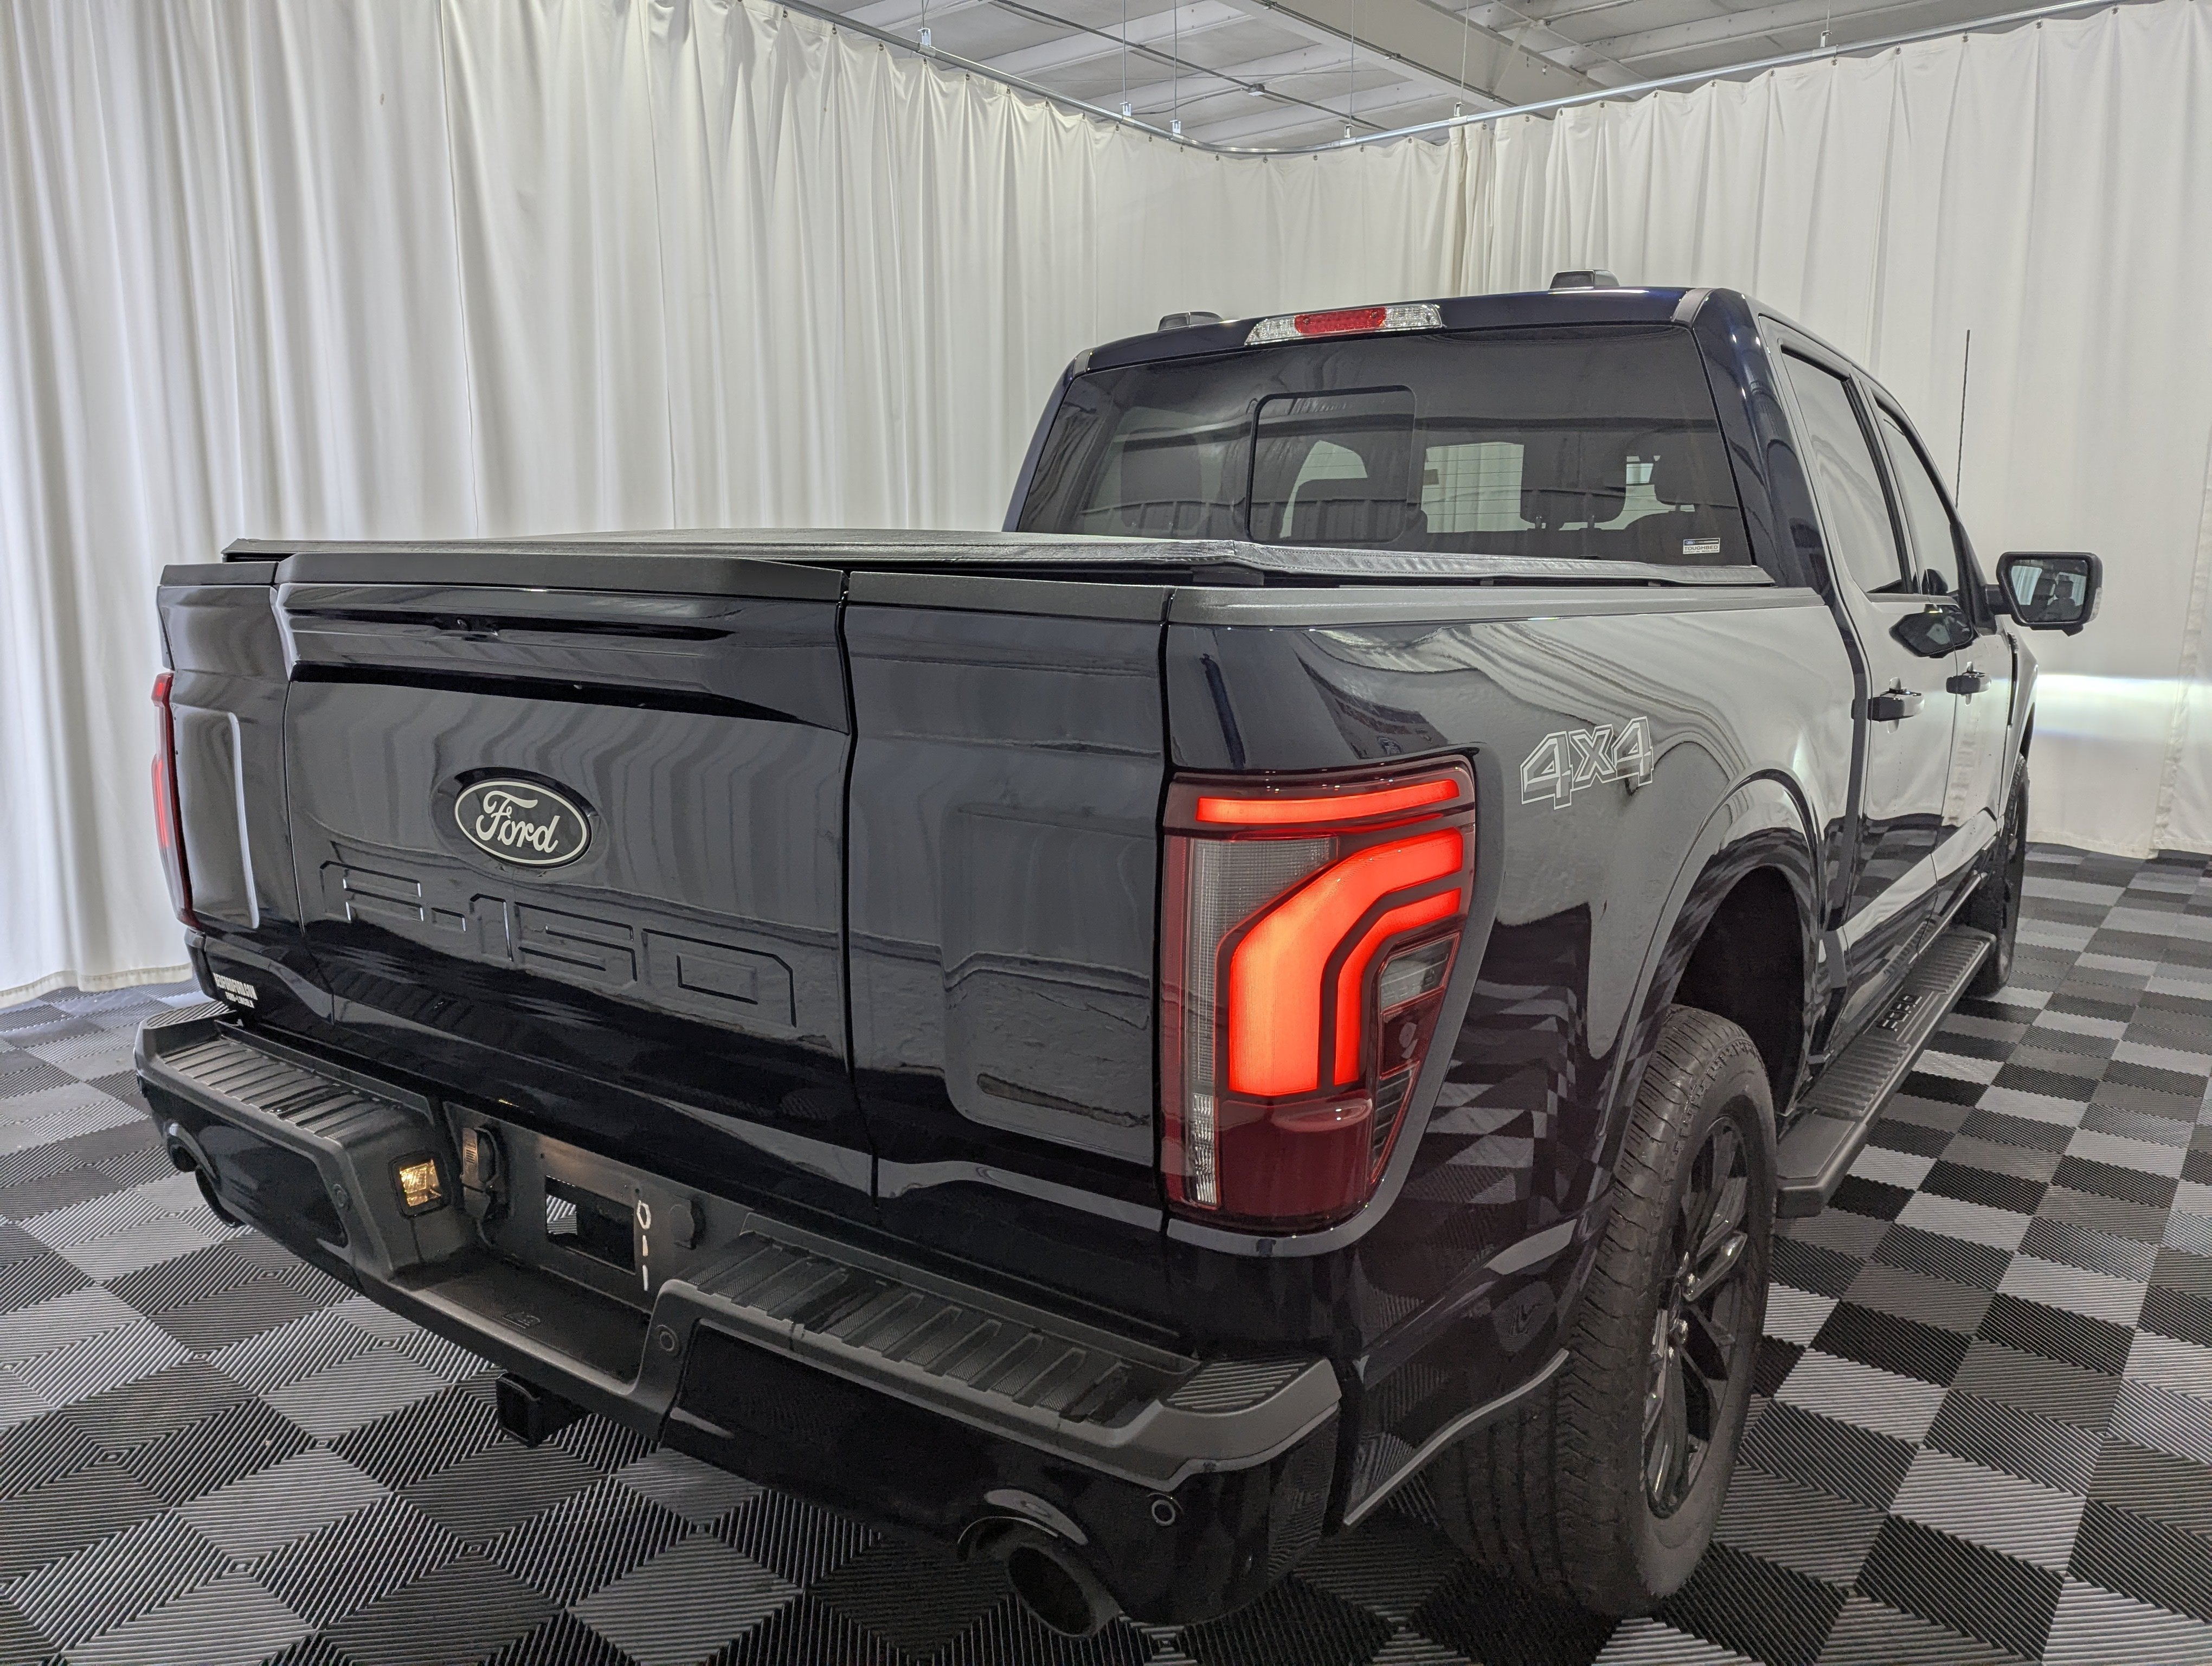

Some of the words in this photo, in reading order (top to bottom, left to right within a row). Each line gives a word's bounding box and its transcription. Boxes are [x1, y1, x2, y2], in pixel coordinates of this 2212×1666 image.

[475, 790, 561, 854] Ford
[321, 860, 798, 1030] F-150
[1876, 994, 1922, 1032] FORD
